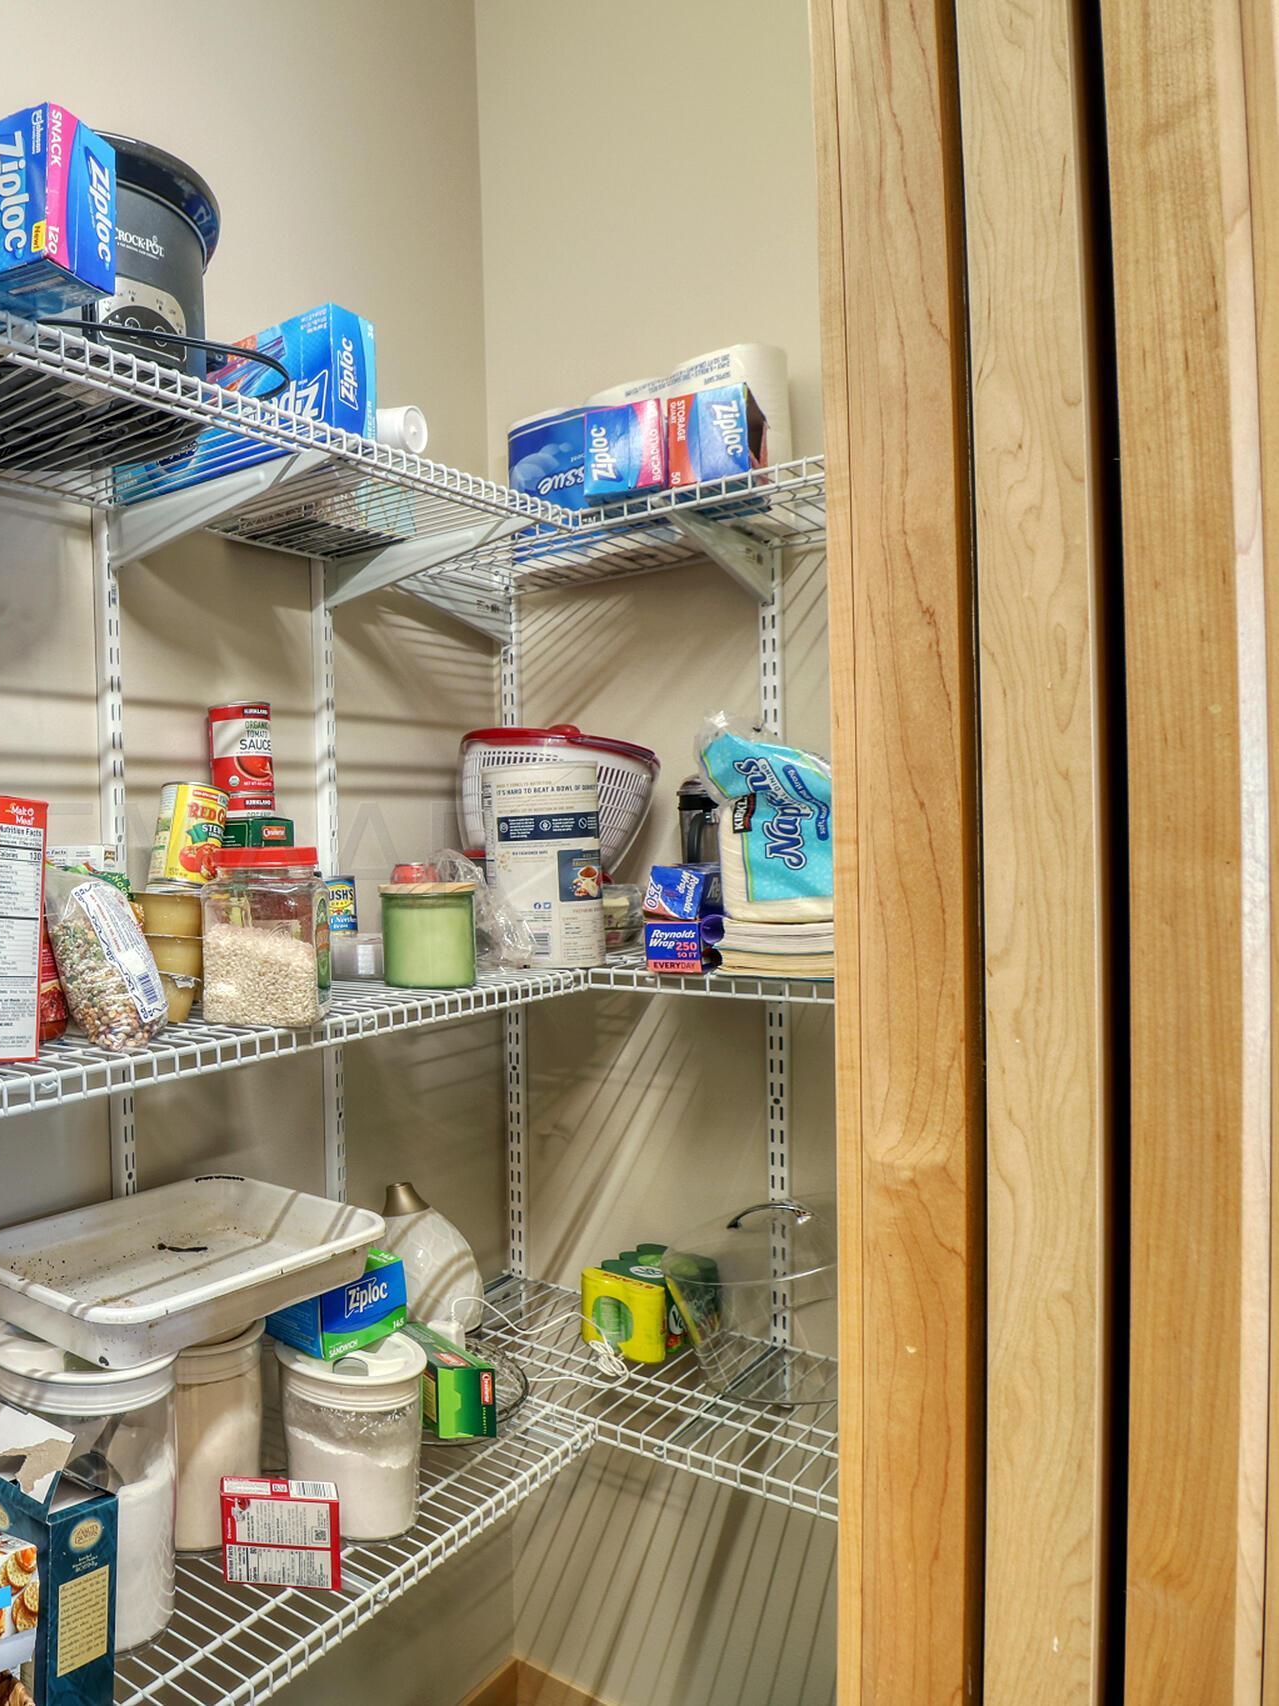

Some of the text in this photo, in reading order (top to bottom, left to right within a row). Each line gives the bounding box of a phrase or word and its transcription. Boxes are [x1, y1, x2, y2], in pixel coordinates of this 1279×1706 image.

[45, 109, 63, 256] SNACK 120
[87, 153, 112, 264] Ziploc
[32, 225, 41, 251] New!
[339, 336, 354, 402] Ziploc
[676, 400, 686, 442] STORAGE
[711, 399, 744, 457] Ziploc
[588, 424, 617, 481] Ziploc
[651, 428, 660, 482] BOCADILLO
[670, 471, 681, 484] 50
[239, 739, 271, 751] SAUCE
[556, 784, 573, 792] BOWL
[10, 804, 28, 816] Malt
[188, 802, 217, 822] RED
[16, 816, 35, 826] Meal
[25, 828, 42, 838] Facts
[29, 851, 41, 861] 130
[678, 870, 693, 894] Wrap
[644, 882, 663, 909] 250
[684, 871, 700, 914] Reynolds
[649, 938, 698, 951] Wrap 250
[651, 929, 696, 942] Reynolds
[677, 951, 698, 959] SQ FT
[653, 961, 696, 970] EVERYDAY
[347, 1281, 388, 1313] Ziploc
[392, 1317, 405, 1329] 145
[328, 1338, 359, 1359] SANDWICH
